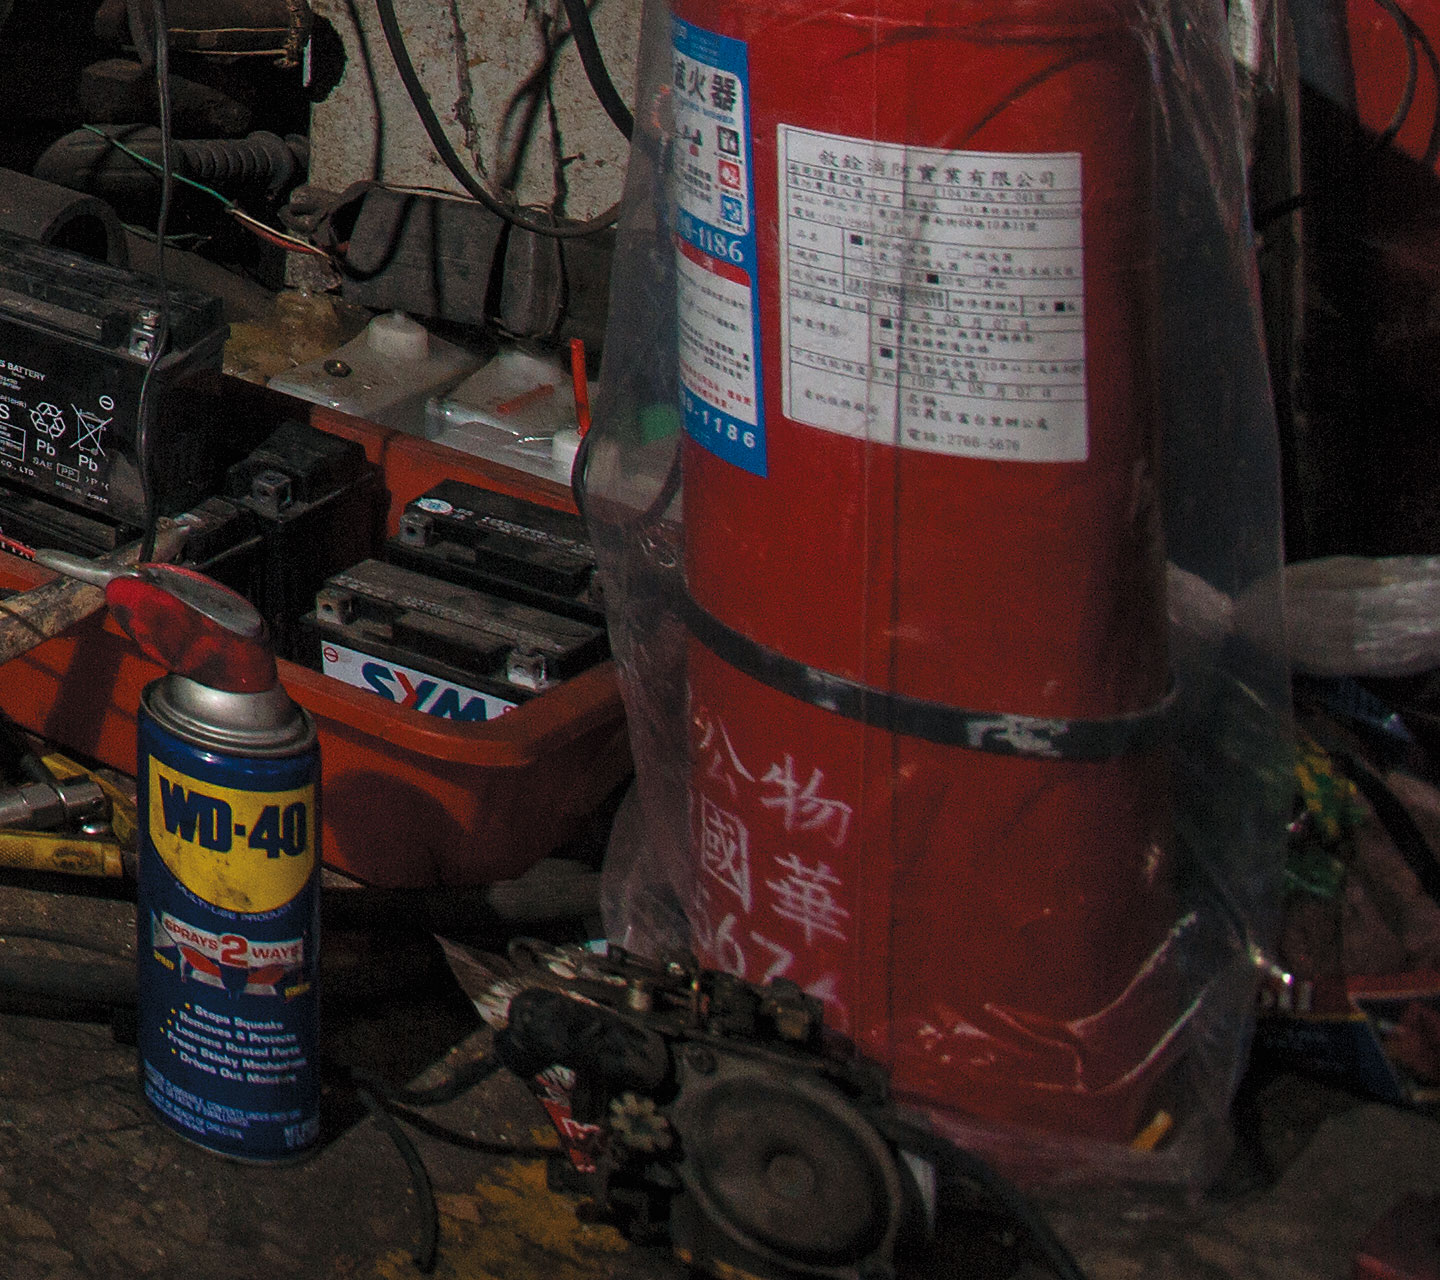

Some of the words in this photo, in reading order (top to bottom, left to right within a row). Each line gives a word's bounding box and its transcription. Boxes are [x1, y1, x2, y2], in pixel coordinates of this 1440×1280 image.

[6, 361, 47, 382] BATTERY
[36, 438, 56, 457] Pb
[19, 465, 38, 478] LTD.
[78, 454, 98, 472] Pb
[363, 659, 492, 721] SYM
[159, 772, 308, 859] WD-40
[164, 918, 219, 951] SPRAYS
[220, 933, 249, 968] 2
[251, 944, 300, 962] WAYS
[179, 1010, 233, 1037] Removes
[194, 1005, 231, 1025] Stops
[167, 1030, 198, 1054] Frees
[200, 1044, 239, 1070] Sticky
[175, 1022, 223, 1047] Loosens
[225, 1040, 268, 1057] Rusted
[180, 1052, 217, 1076] Drives
[219, 1066, 244, 1082] Out
